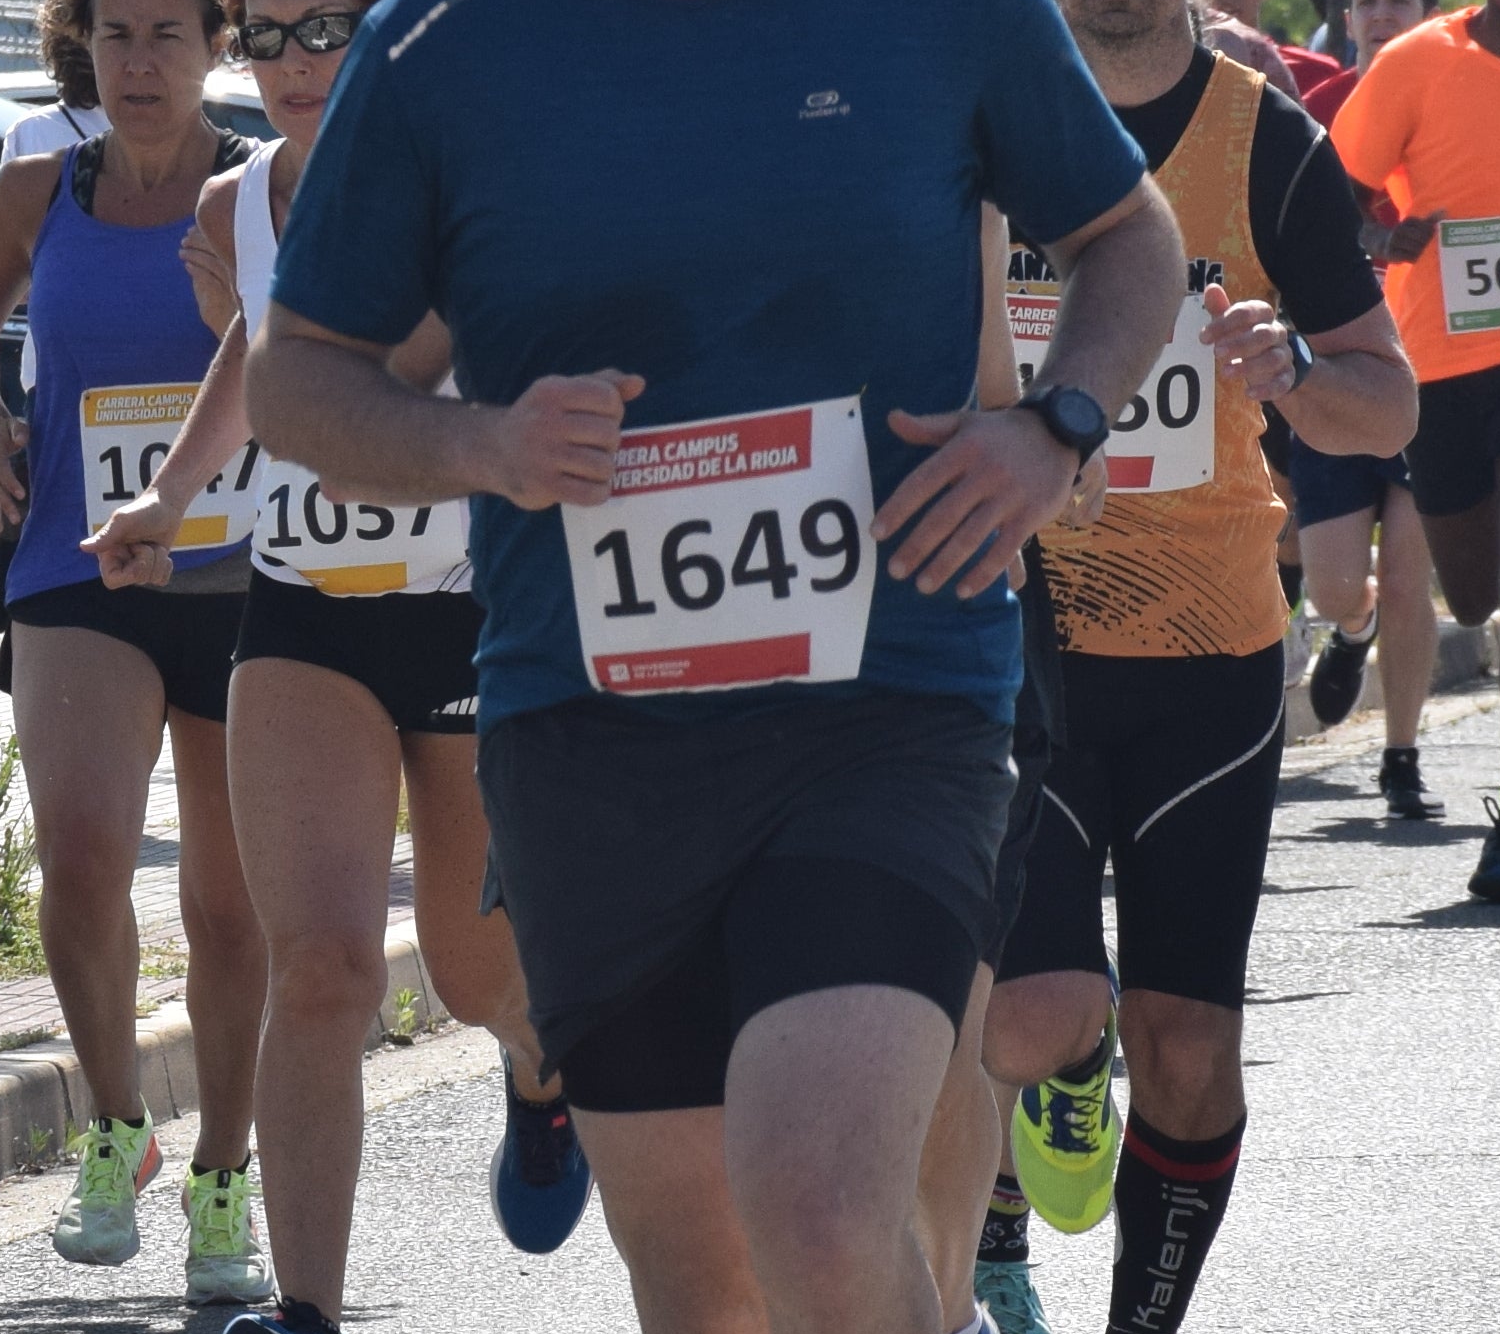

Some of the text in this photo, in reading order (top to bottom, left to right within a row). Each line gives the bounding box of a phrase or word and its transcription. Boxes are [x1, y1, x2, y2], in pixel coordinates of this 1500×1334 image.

[1008, 306, 1058, 320] CARRER
[97, 393, 193, 409] CARRERA CAMPUS
[95, 409, 165, 422] UNIVERSIDAD
[167, 406, 181, 417] DE
[612, 433, 739, 467] RERA CAMPUS
[698, 457, 721, 478] DE
[724, 455, 747, 474] LA
[751, 445, 798, 470] RIOJA
[594, 498, 861, 617] 1649
